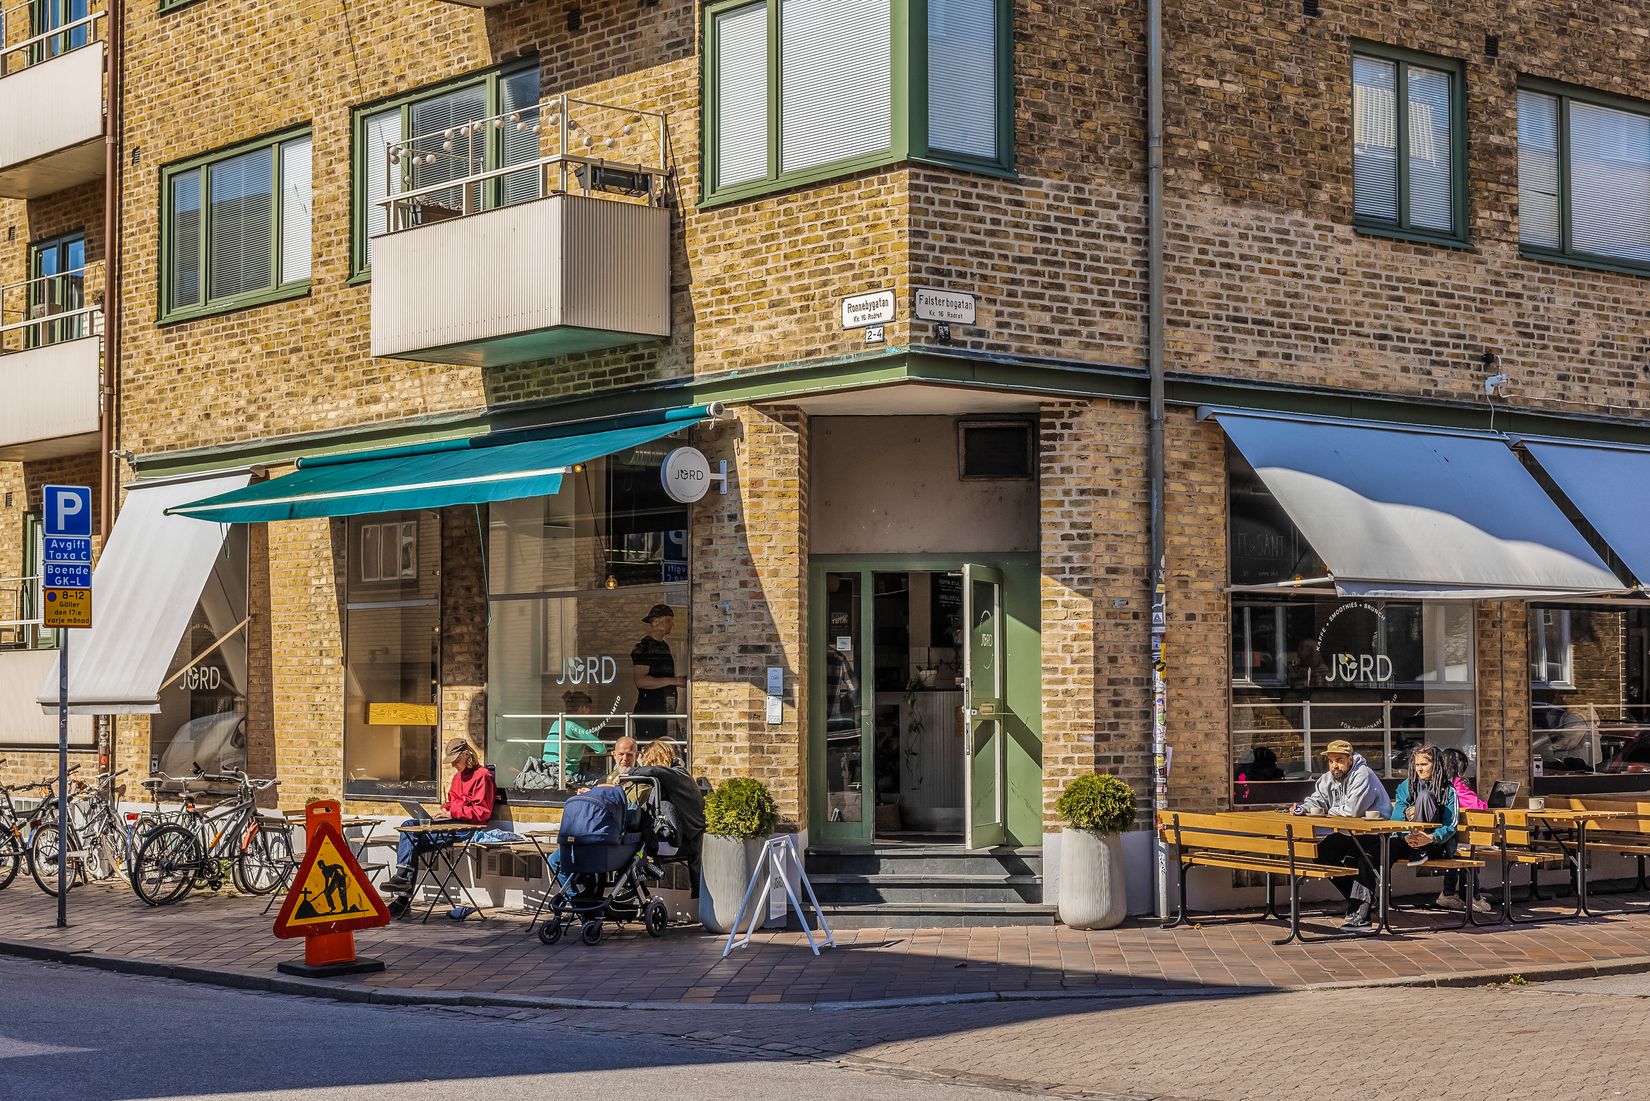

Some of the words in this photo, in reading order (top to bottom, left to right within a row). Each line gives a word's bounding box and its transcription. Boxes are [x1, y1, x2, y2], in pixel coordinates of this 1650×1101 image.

[847, 298, 889, 313] Ronnebygatan
[919, 295, 973, 310] Falsterbogatan
[867, 329, 882, 340] 2-4
[57, 491, 83, 531] P
[51, 539, 85, 550] Avgift
[49, 551, 76, 560] Taxa
[80, 551, 87, 560] C
[47, 565, 89, 575] Boende
[54, 576, 82, 586] GK-L
[62, 591, 85, 600] 8-12
[66, 616, 90, 624] månad
[1316, 627, 1326, 651] KAFFE
[1329, 602, 1358, 621] SMOOTHIES
[1363, 603, 1386, 621] BRUNCH
